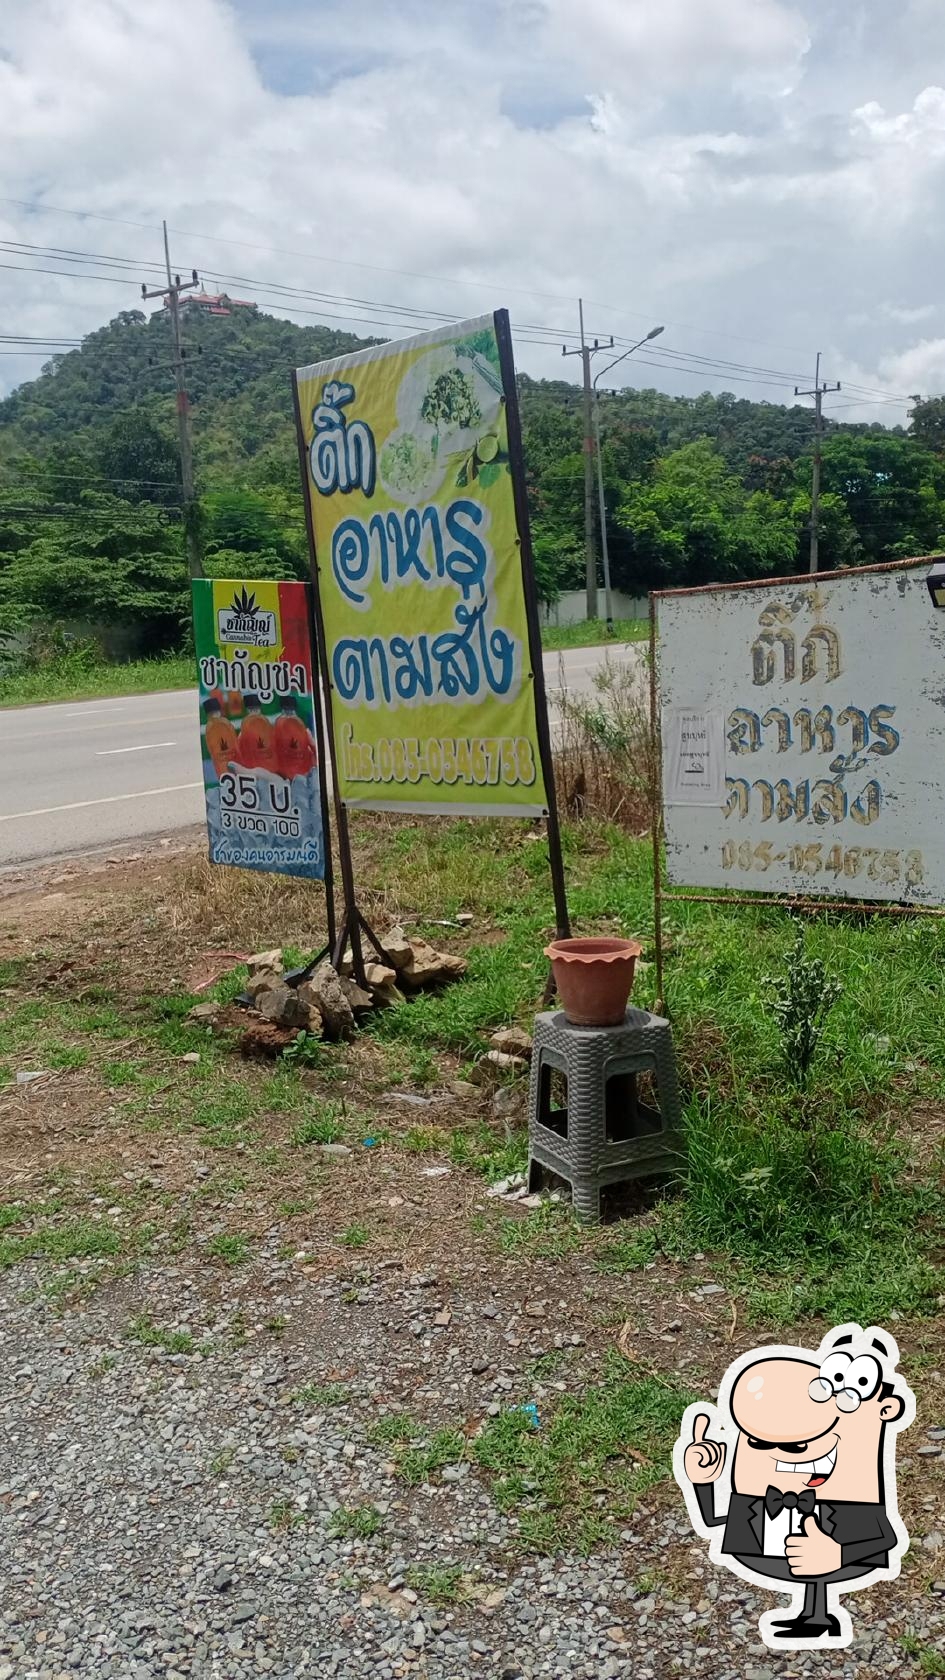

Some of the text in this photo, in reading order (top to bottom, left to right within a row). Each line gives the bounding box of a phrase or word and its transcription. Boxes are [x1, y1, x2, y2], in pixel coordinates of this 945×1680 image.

[332, 500, 487, 603] อาหาร
[253, 633, 270, 647] Tea
[333, 594, 515, 703] ตามสั่ง
[200, 650, 306, 700] ชากัญชง
[727, 704, 900, 757] อาหาร
[220, 774, 257, 809] 35
[223, 813, 300, 837] 3 ขวด 100
